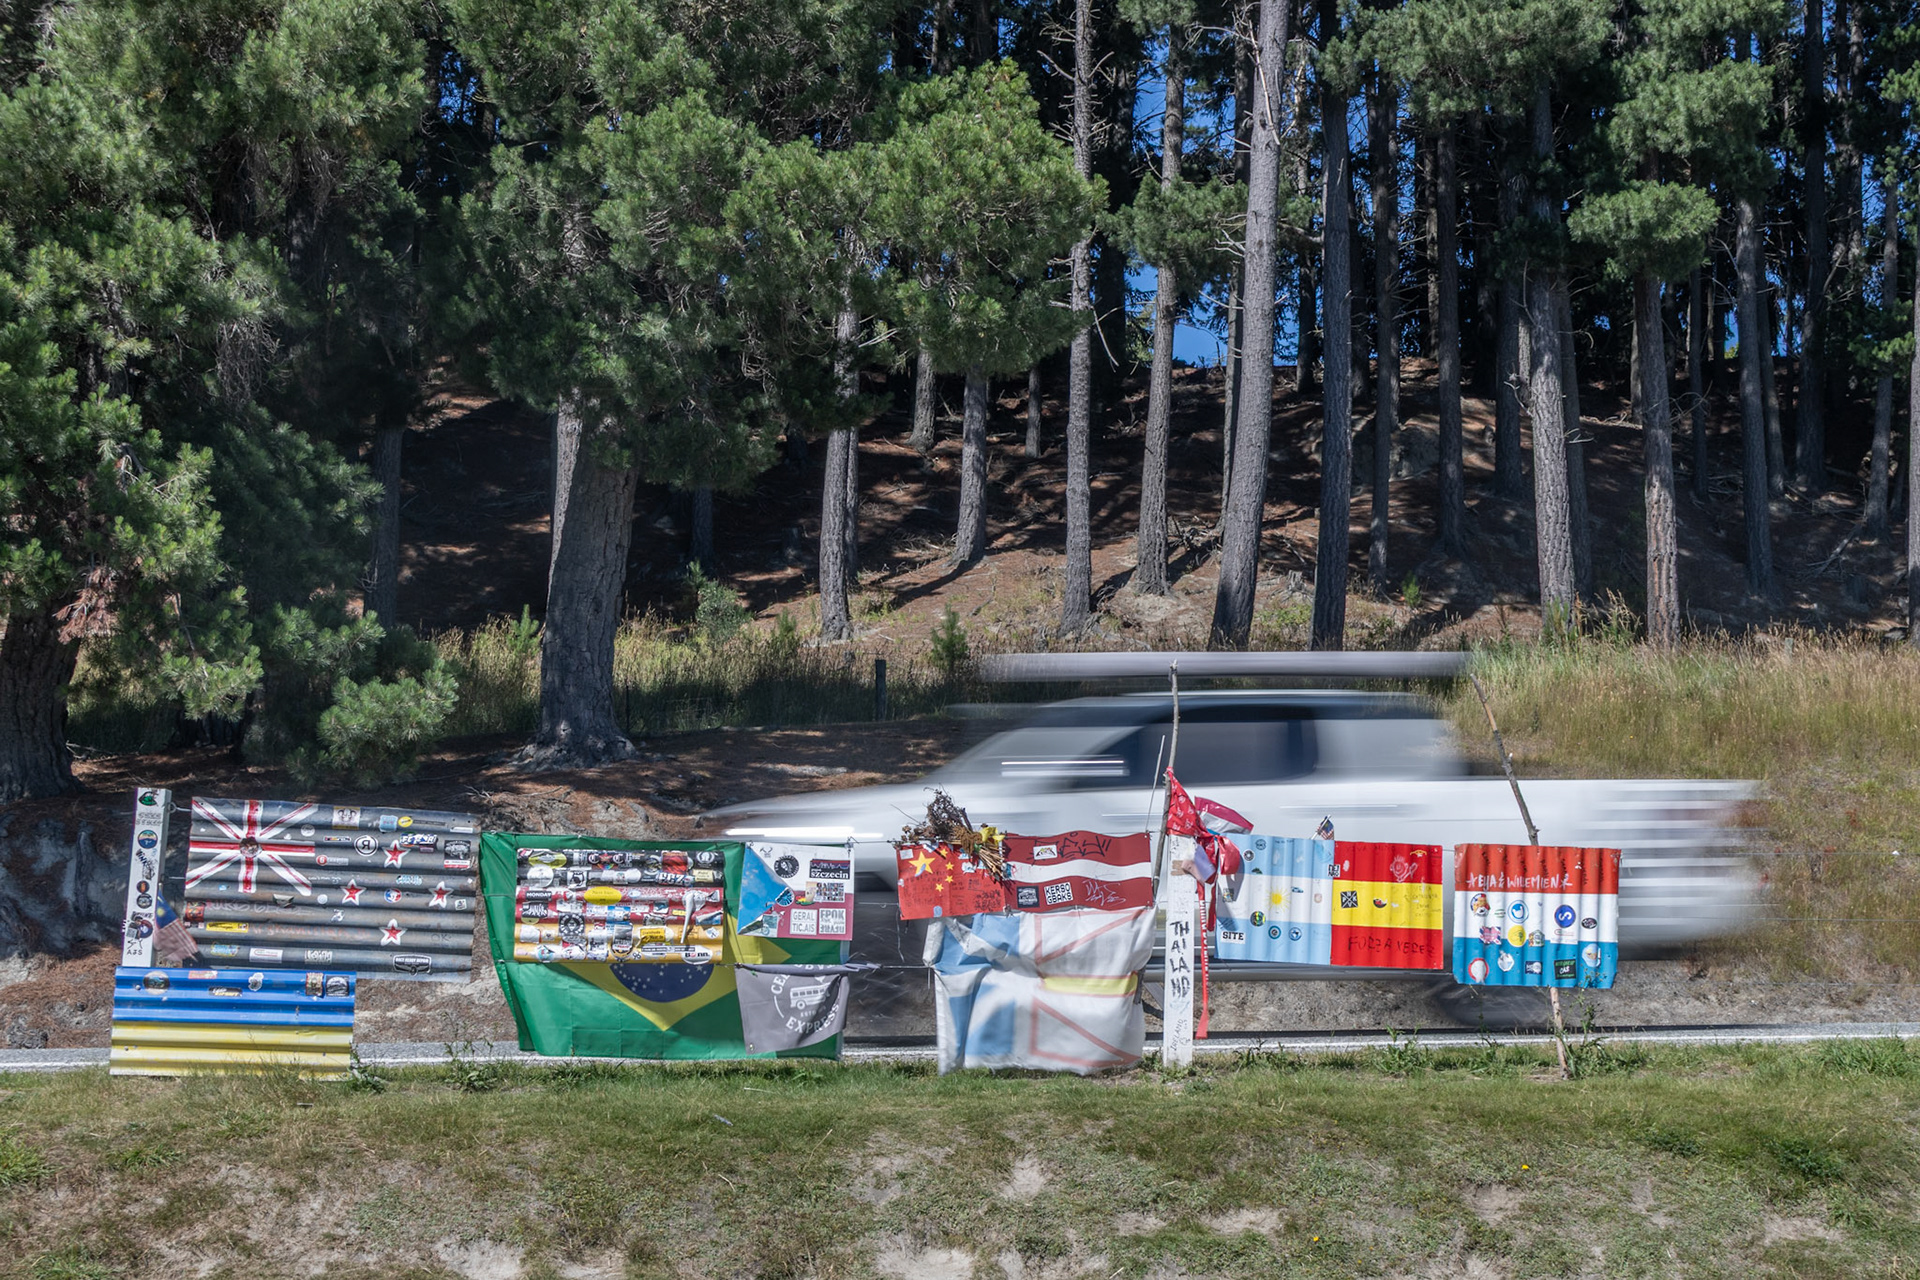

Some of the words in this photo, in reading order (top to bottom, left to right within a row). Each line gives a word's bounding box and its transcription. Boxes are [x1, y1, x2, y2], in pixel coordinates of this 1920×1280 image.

[811, 870, 849, 879] szczecin
[792, 911, 815, 921] GERAL
[1222, 931, 1244, 941] SITE
